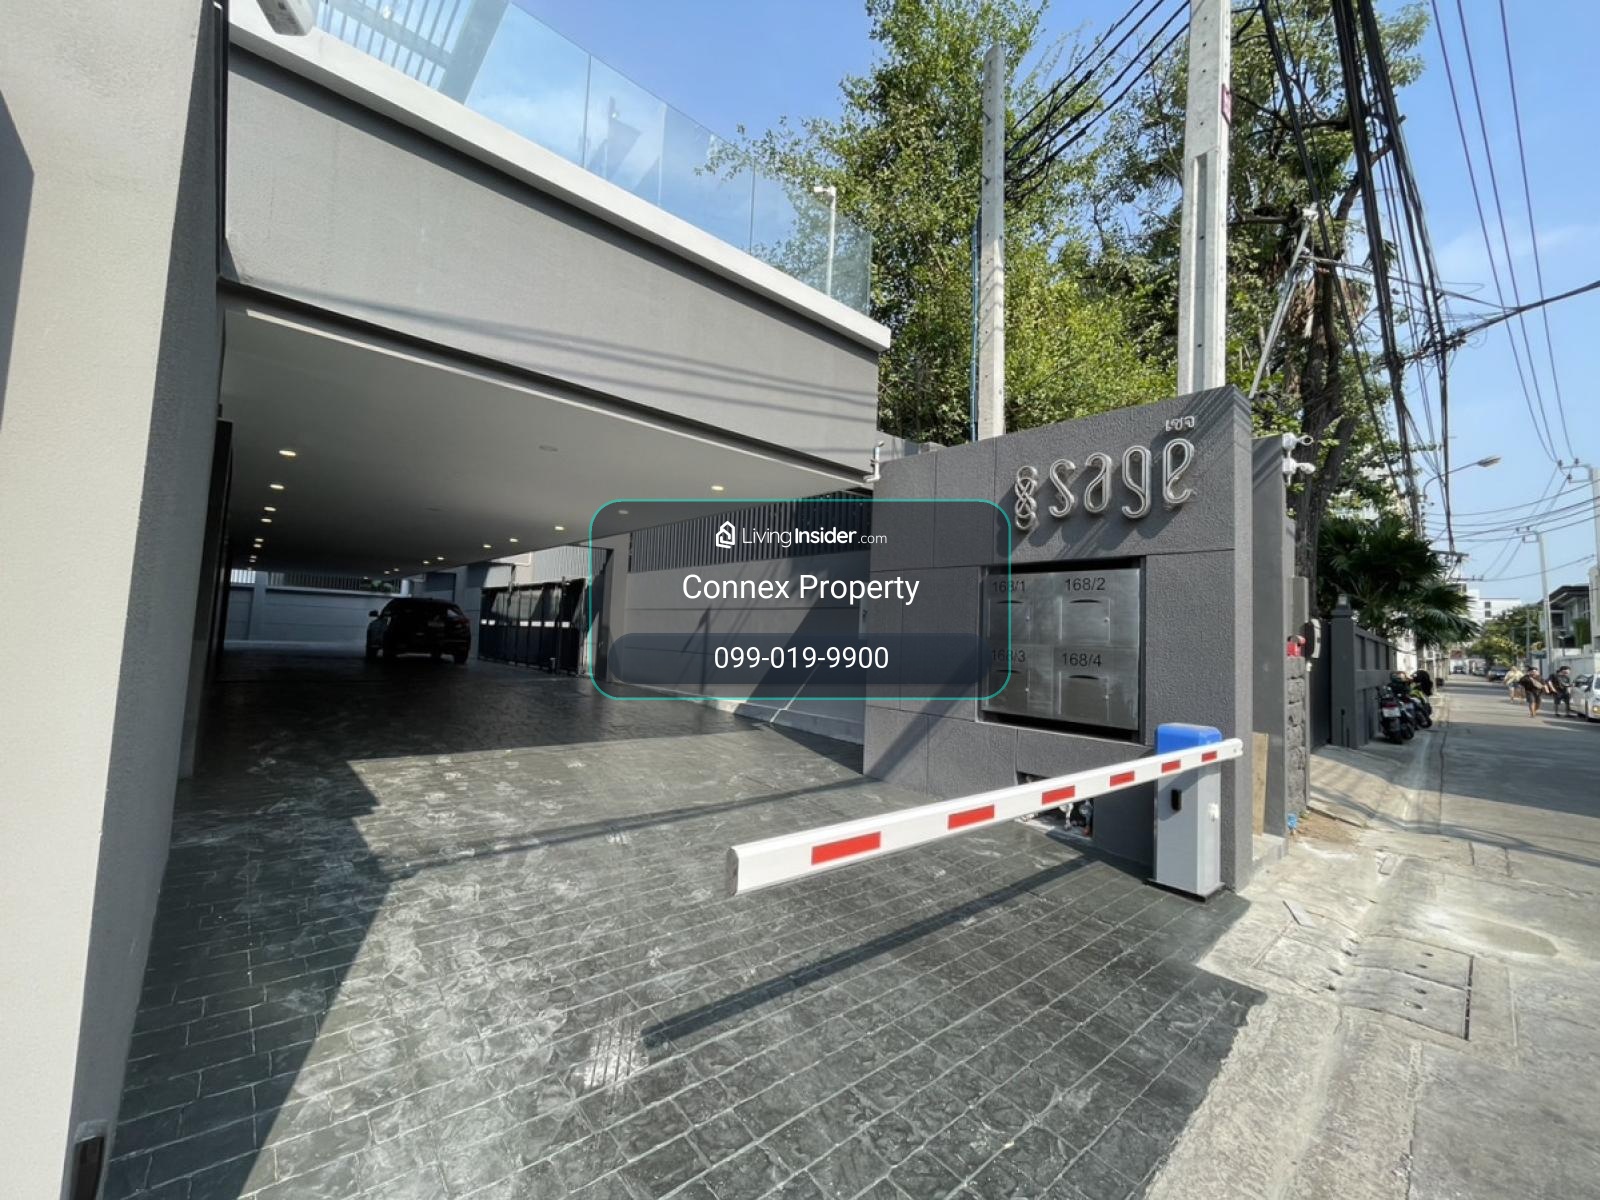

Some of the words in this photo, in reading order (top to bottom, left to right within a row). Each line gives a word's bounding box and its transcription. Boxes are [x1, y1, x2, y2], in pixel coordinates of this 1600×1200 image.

[1049, 438, 1195, 519] sage
[1065, 577, 1106, 591] 168/2
[1062, 652, 1103, 667] 168/4
